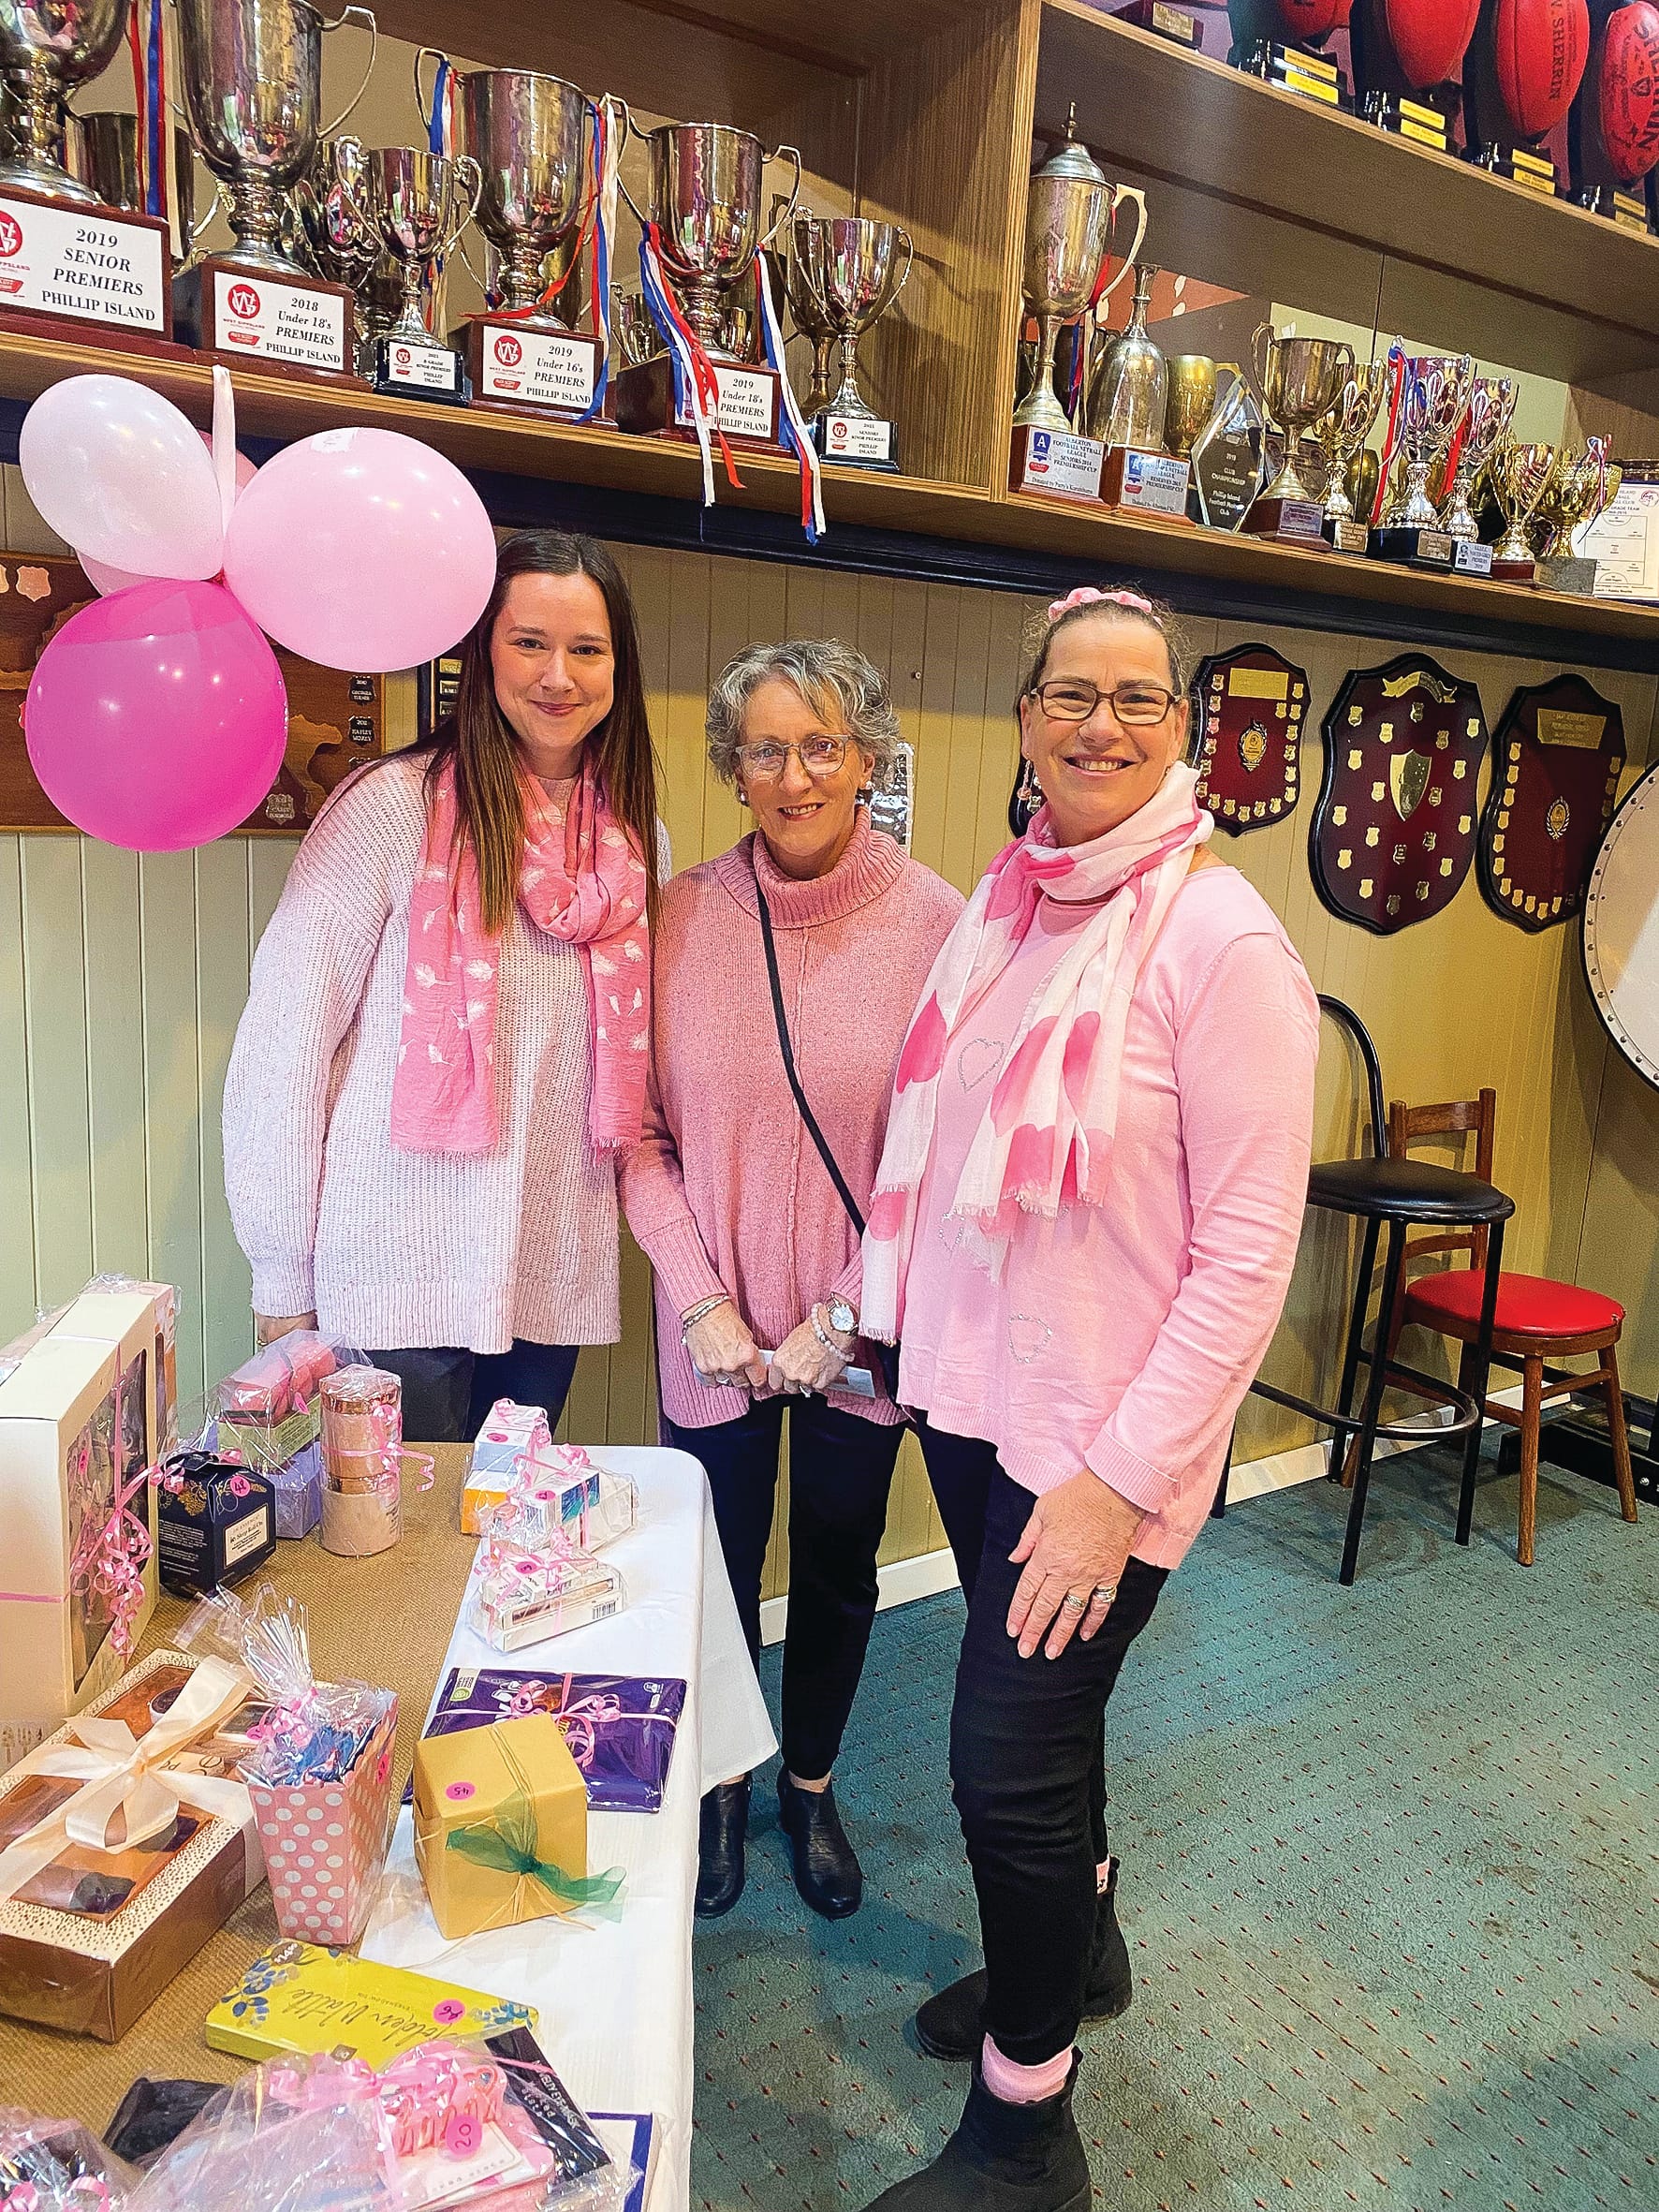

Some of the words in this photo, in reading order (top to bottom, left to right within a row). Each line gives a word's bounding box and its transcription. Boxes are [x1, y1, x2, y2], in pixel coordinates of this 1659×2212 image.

[1549, 17, 1565, 101] SHERRIN
[76, 228, 119, 249] 2019
[64, 247, 131, 273] SENIOR
[53, 267, 144, 297] PREMIERS
[42, 289, 101, 315] PHILLIP
[104, 301, 155, 322] ISLAND
[291, 297, 319, 312] 2018
[278, 311, 309, 325] Under
[313, 317, 332, 330] 18's
[275, 326, 335, 347] PREMIERS
[266, 343, 305, 357] PHILLIP
[307, 349, 341, 363] ISLAND
[548, 345, 573, 358] 2019
[536, 357, 564, 370] Under
[566, 361, 584, 373] 16's
[534, 371, 586, 388] PREMIERS
[732, 377, 755, 390] 2019
[526, 387, 560, 399] PHILLIP
[562, 391, 591, 404] ISLAND
[722, 390, 746, 401] Under
[720, 403, 765, 418] PREMIERS
[743, 420, 769, 432] ISLAND
[282, 1987, 370, 2028] Wattle
